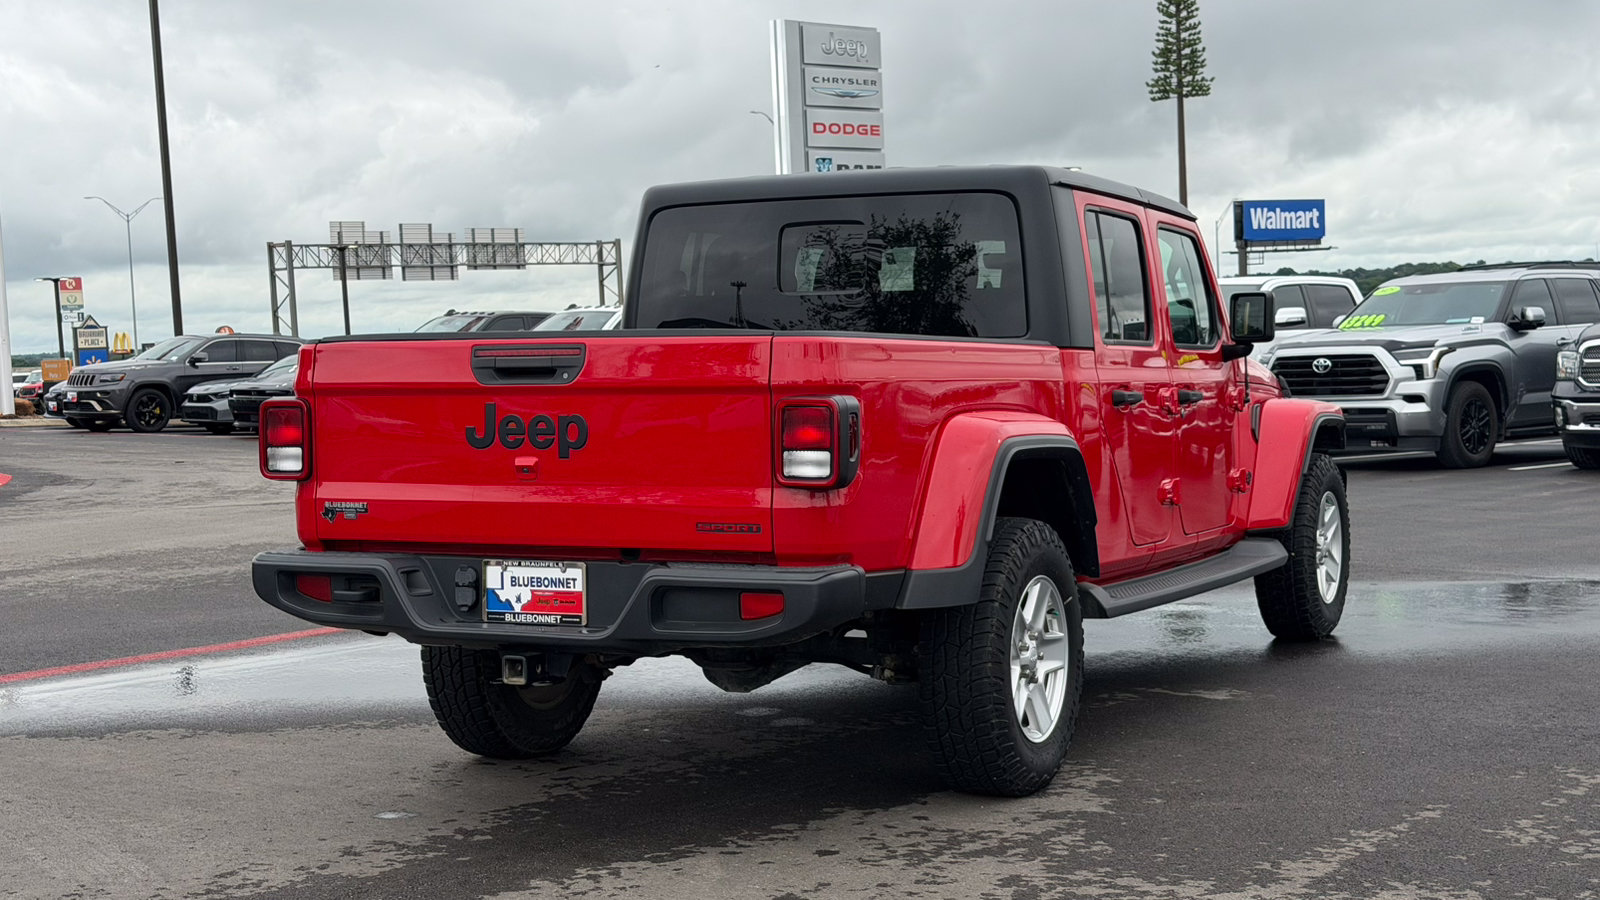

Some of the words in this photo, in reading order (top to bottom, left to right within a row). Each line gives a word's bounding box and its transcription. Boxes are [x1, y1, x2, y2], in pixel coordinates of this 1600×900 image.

[821, 32, 868, 62] Jeep
[812, 76, 878, 87] CHRYSLER
[813, 122, 881, 136] DODGE
[1250, 207, 1320, 230] Walmart
[465, 402, 589, 459] Jeep
[696, 522, 761, 533] SPORT
[510, 576, 578, 589] BLUEBONNET
[505, 613, 562, 624] BLUEBONNET
